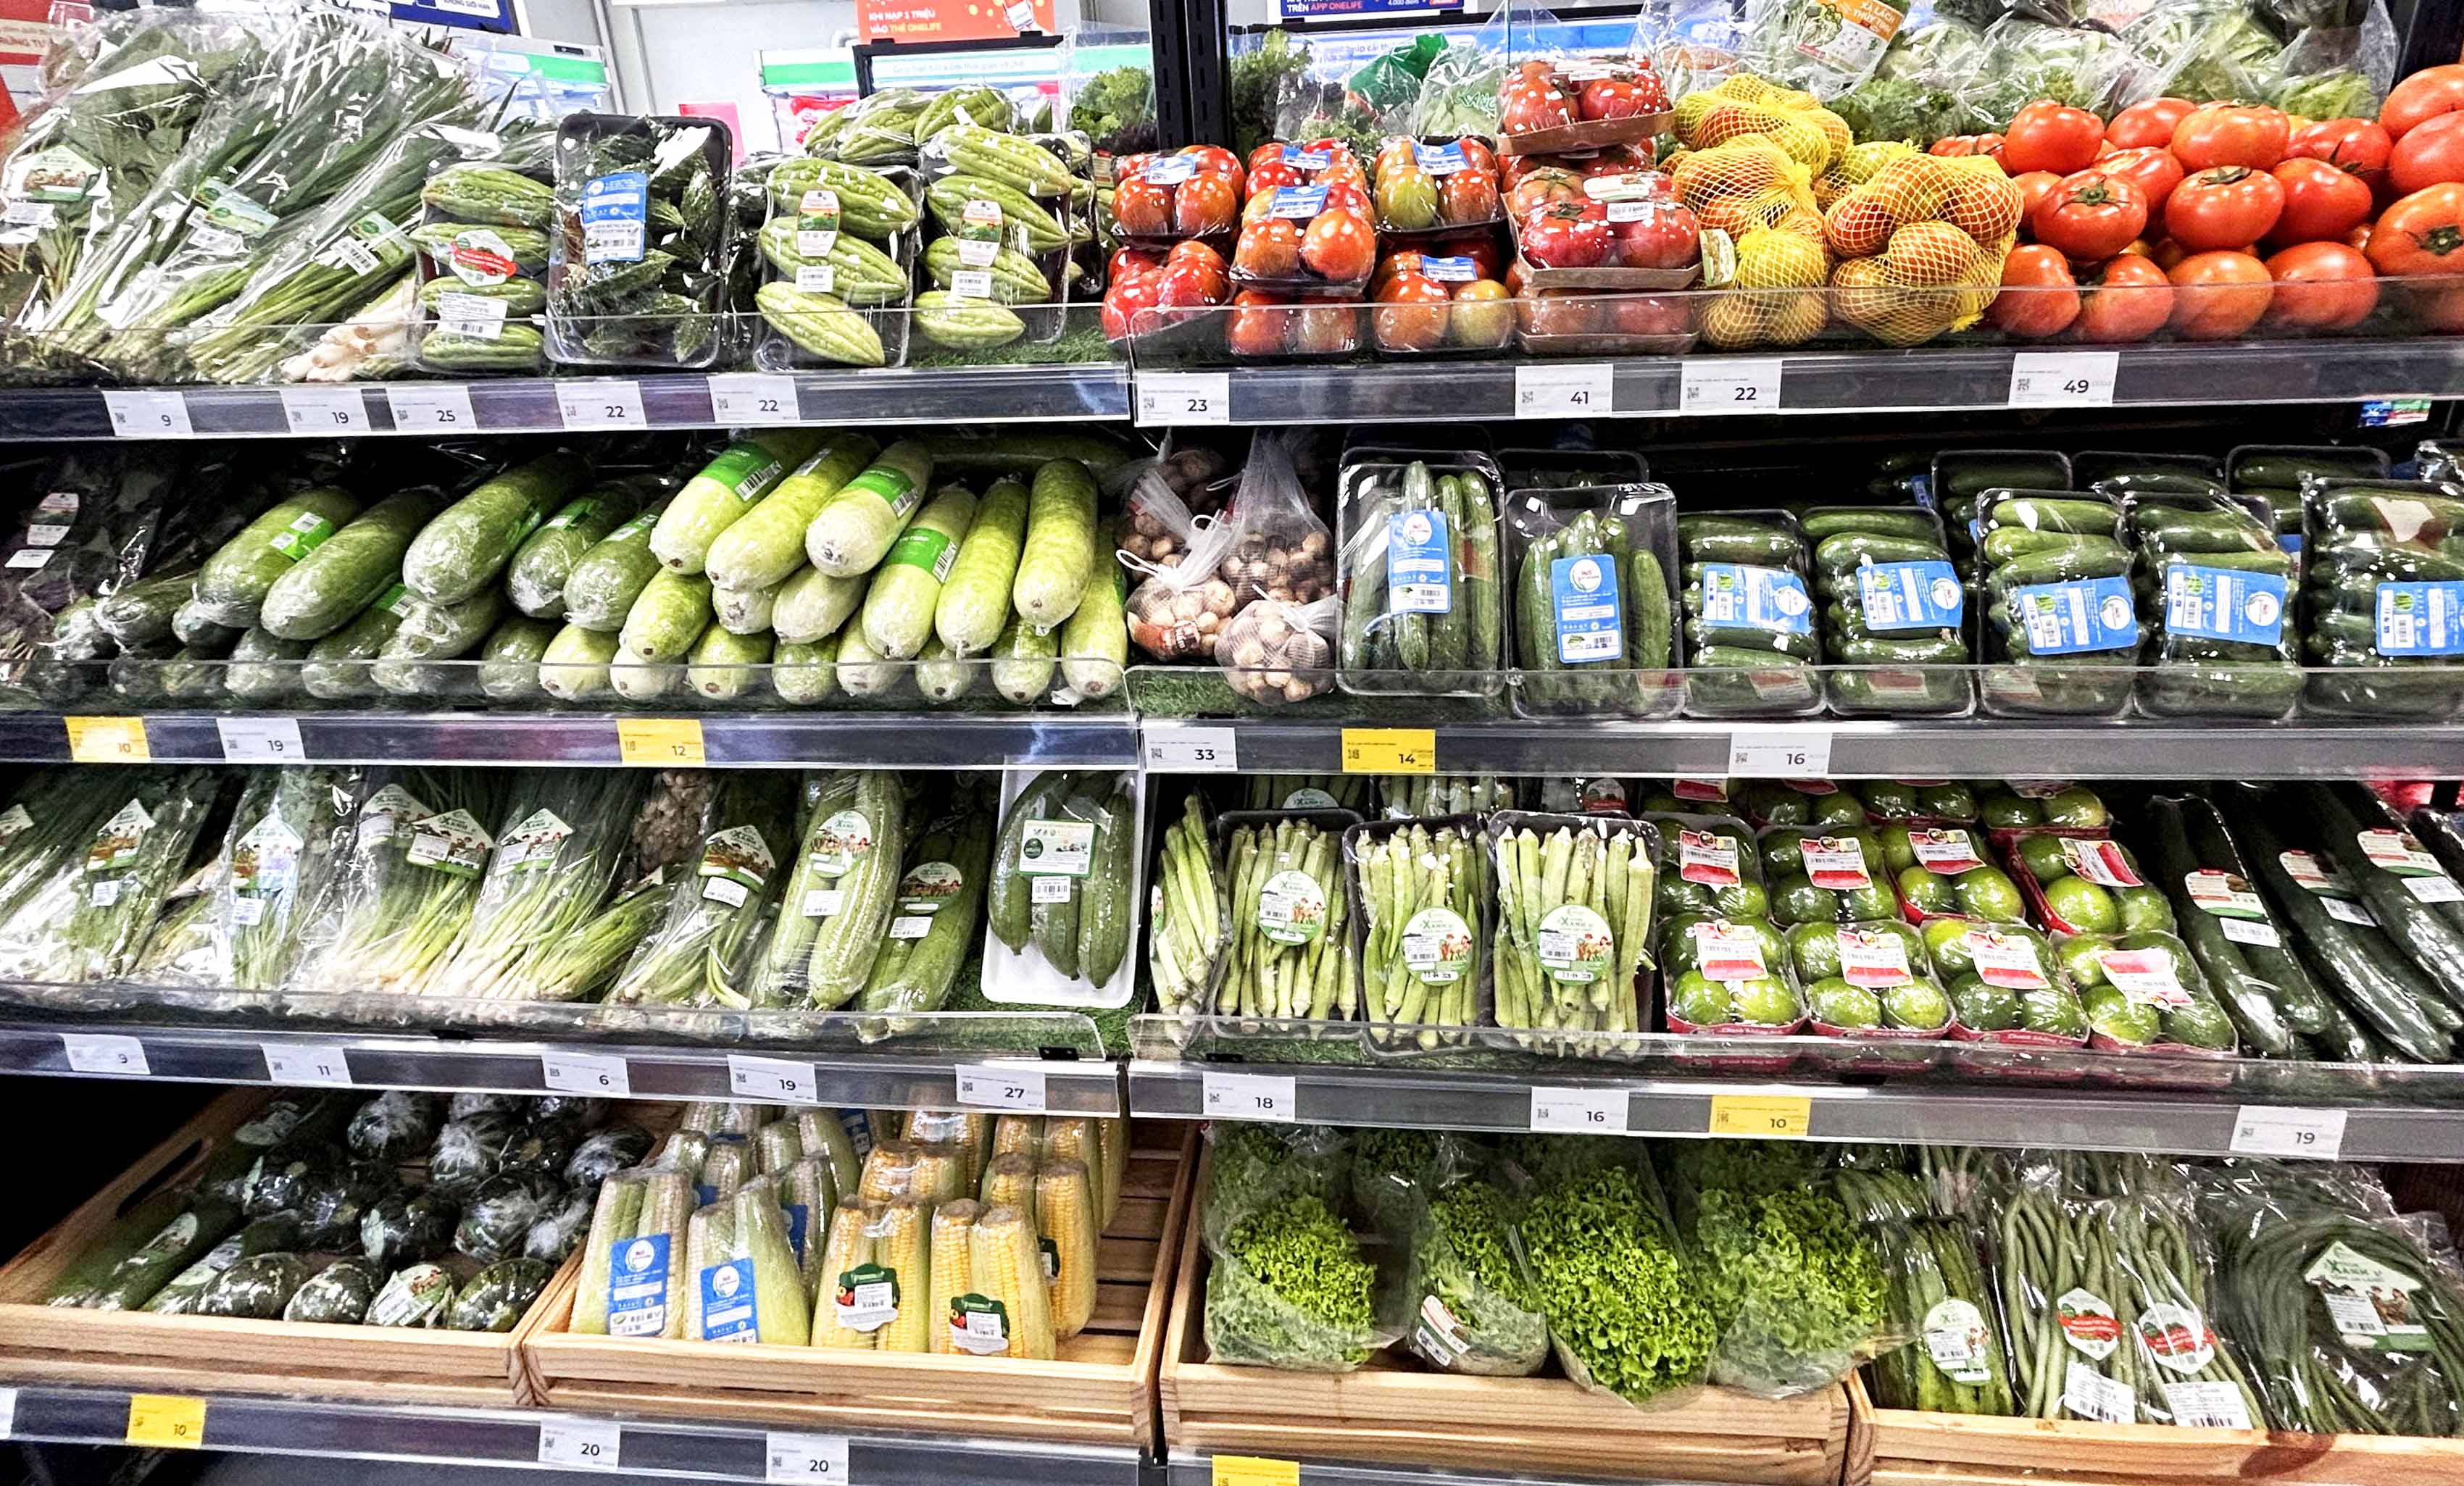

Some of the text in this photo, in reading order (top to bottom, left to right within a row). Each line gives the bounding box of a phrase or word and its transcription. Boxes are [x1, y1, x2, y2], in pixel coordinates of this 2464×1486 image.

[1287, 2, 1309, 12] TRÊN
[1328, 1, 1363, 10] ONELIFE
[869, 12, 884, 21] KHI
[911, 8, 936, 20] TRIỆU
[870, 22, 888, 33] VÀO
[907, 21, 941, 32] ONELIFE
[2063, 380, 2089, 393] 49
[1570, 391, 1589, 404] 41
[1734, 387, 1757, 401] 22
[759, 399, 779, 412] 22
[1188, 398, 1207, 412] 23
[436, 409, 456, 422] 25
[605, 405, 625, 418] 22
[161, 414, 172, 427] 9
[332, 412, 349, 424] 19
[267, 740, 284, 751] 19
[671, 745, 686, 756] 12
[1195, 749, 1215, 761] 33
[1399, 754, 1415, 764] 14
[1786, 753, 1805, 765] 16
[317, 1065, 330, 1076] 11
[599, 1074, 609, 1085] 6
[779, 1079, 796, 1091] 19
[1004, 1086, 1025, 1099] 27
[1255, 1097, 1273, 1109] 18
[1586, 1111, 1604, 1122] 16
[1770, 1118, 1786, 1128] 10
[2297, 1132, 2315, 1145] 19
[173, 1424, 187, 1437] 10
[581, 1443, 600, 1456] 20
[809, 1459, 829, 1472] 20
